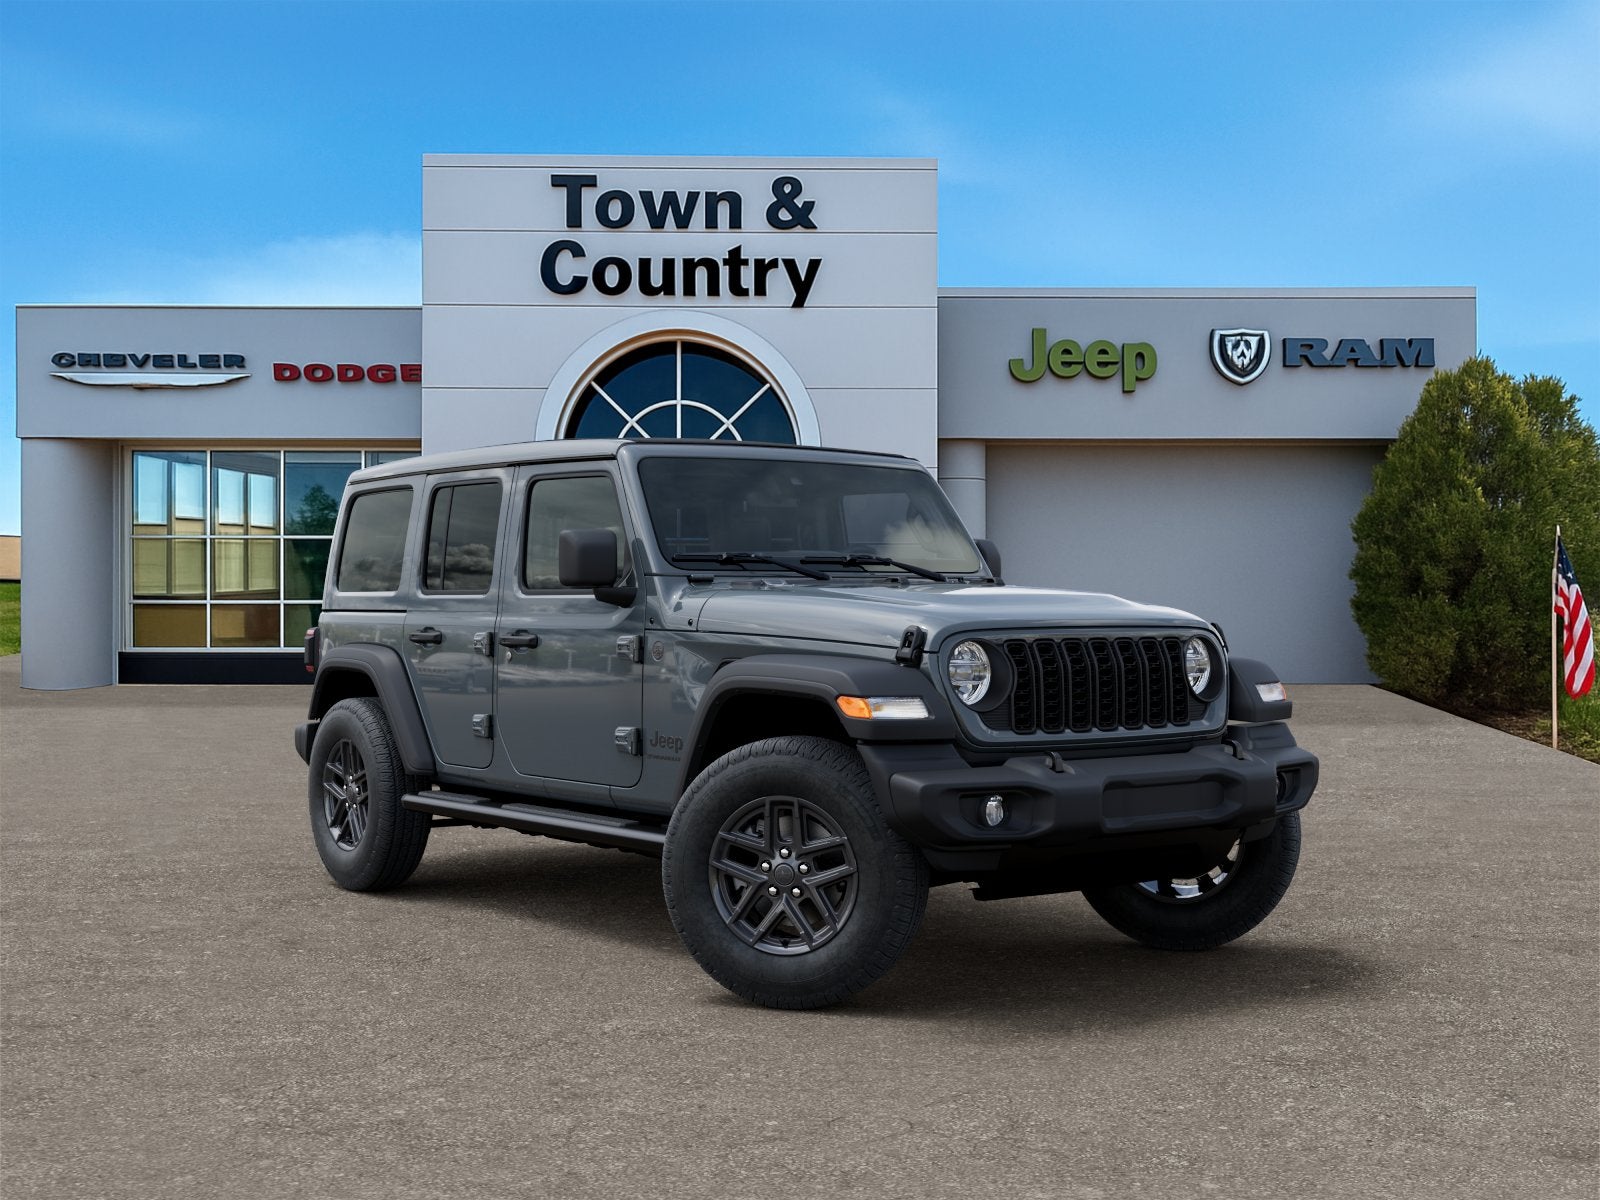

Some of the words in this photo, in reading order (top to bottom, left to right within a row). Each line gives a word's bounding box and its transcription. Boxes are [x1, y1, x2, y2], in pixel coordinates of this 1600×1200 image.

[550, 174, 742, 229] Town
[765, 176, 818, 230] &
[540, 239, 822, 308] Country
[273, 363, 422, 382] DODGE
[1009, 328, 1157, 392] Jeep
[1282, 337, 1435, 367] RAM
[649, 730, 684, 754] Jeep
